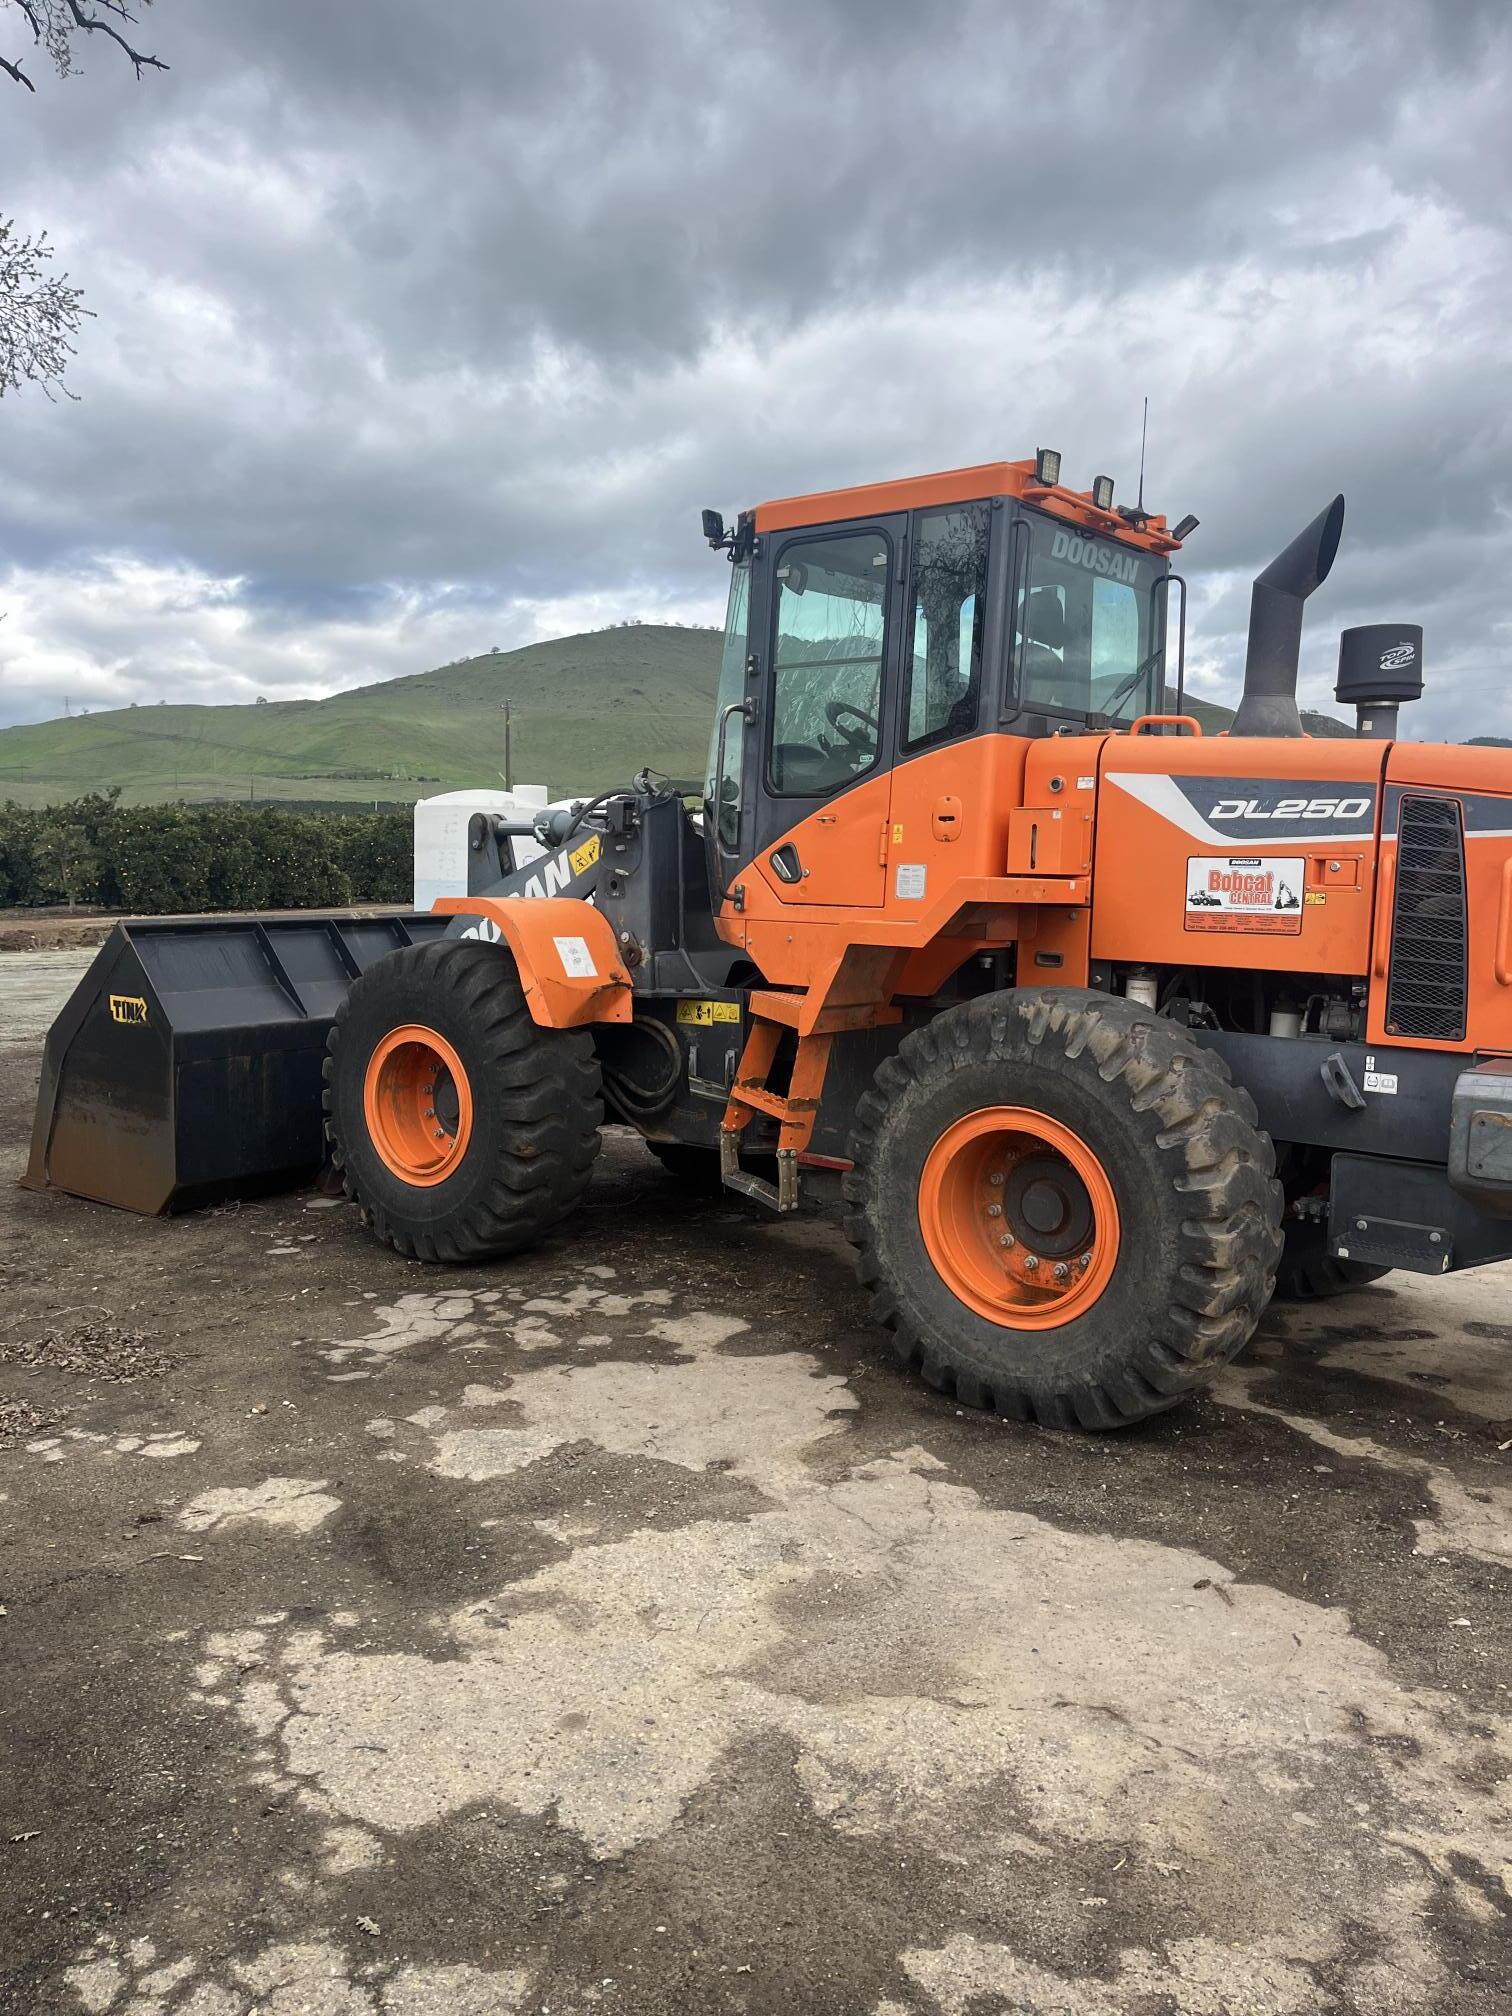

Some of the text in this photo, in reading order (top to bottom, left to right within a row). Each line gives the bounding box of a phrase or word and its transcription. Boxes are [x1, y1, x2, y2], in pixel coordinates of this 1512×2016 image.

[1051, 530, 1140, 584] DOOSAN
[1380, 650, 1405, 662] TOP
[1393, 653, 1416, 665] SPIN
[1208, 798, 1371, 819] DL250
[1207, 869, 1275, 894] Bobcat
[1229, 890, 1273, 905] CENTRAL
[112, 999, 146, 1022] TINK
